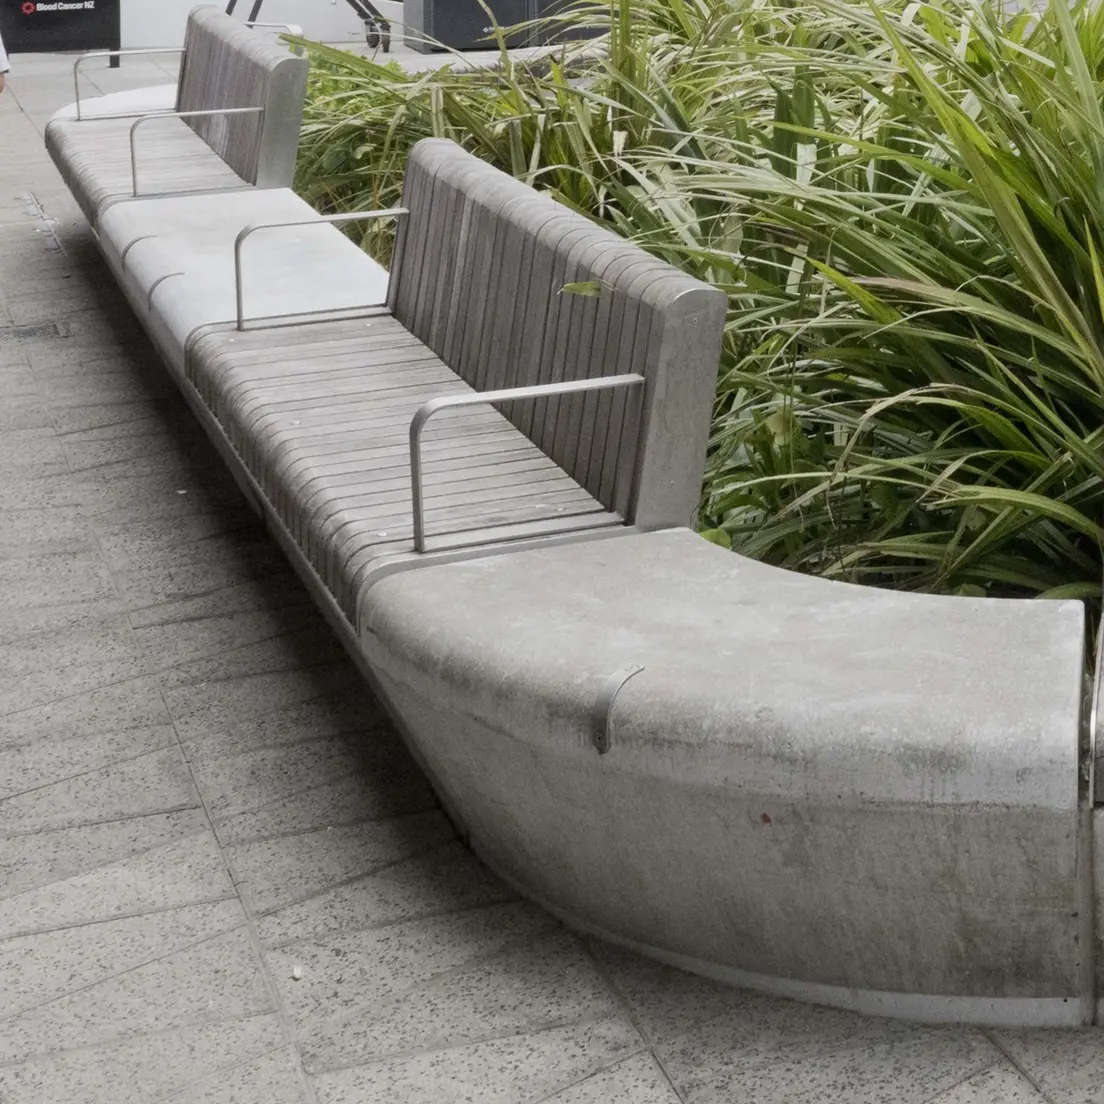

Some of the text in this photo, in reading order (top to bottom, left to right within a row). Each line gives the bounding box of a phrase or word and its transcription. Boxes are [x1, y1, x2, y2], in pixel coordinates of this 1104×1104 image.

[36, 0, 95, 11] Blood Cancer NZ
